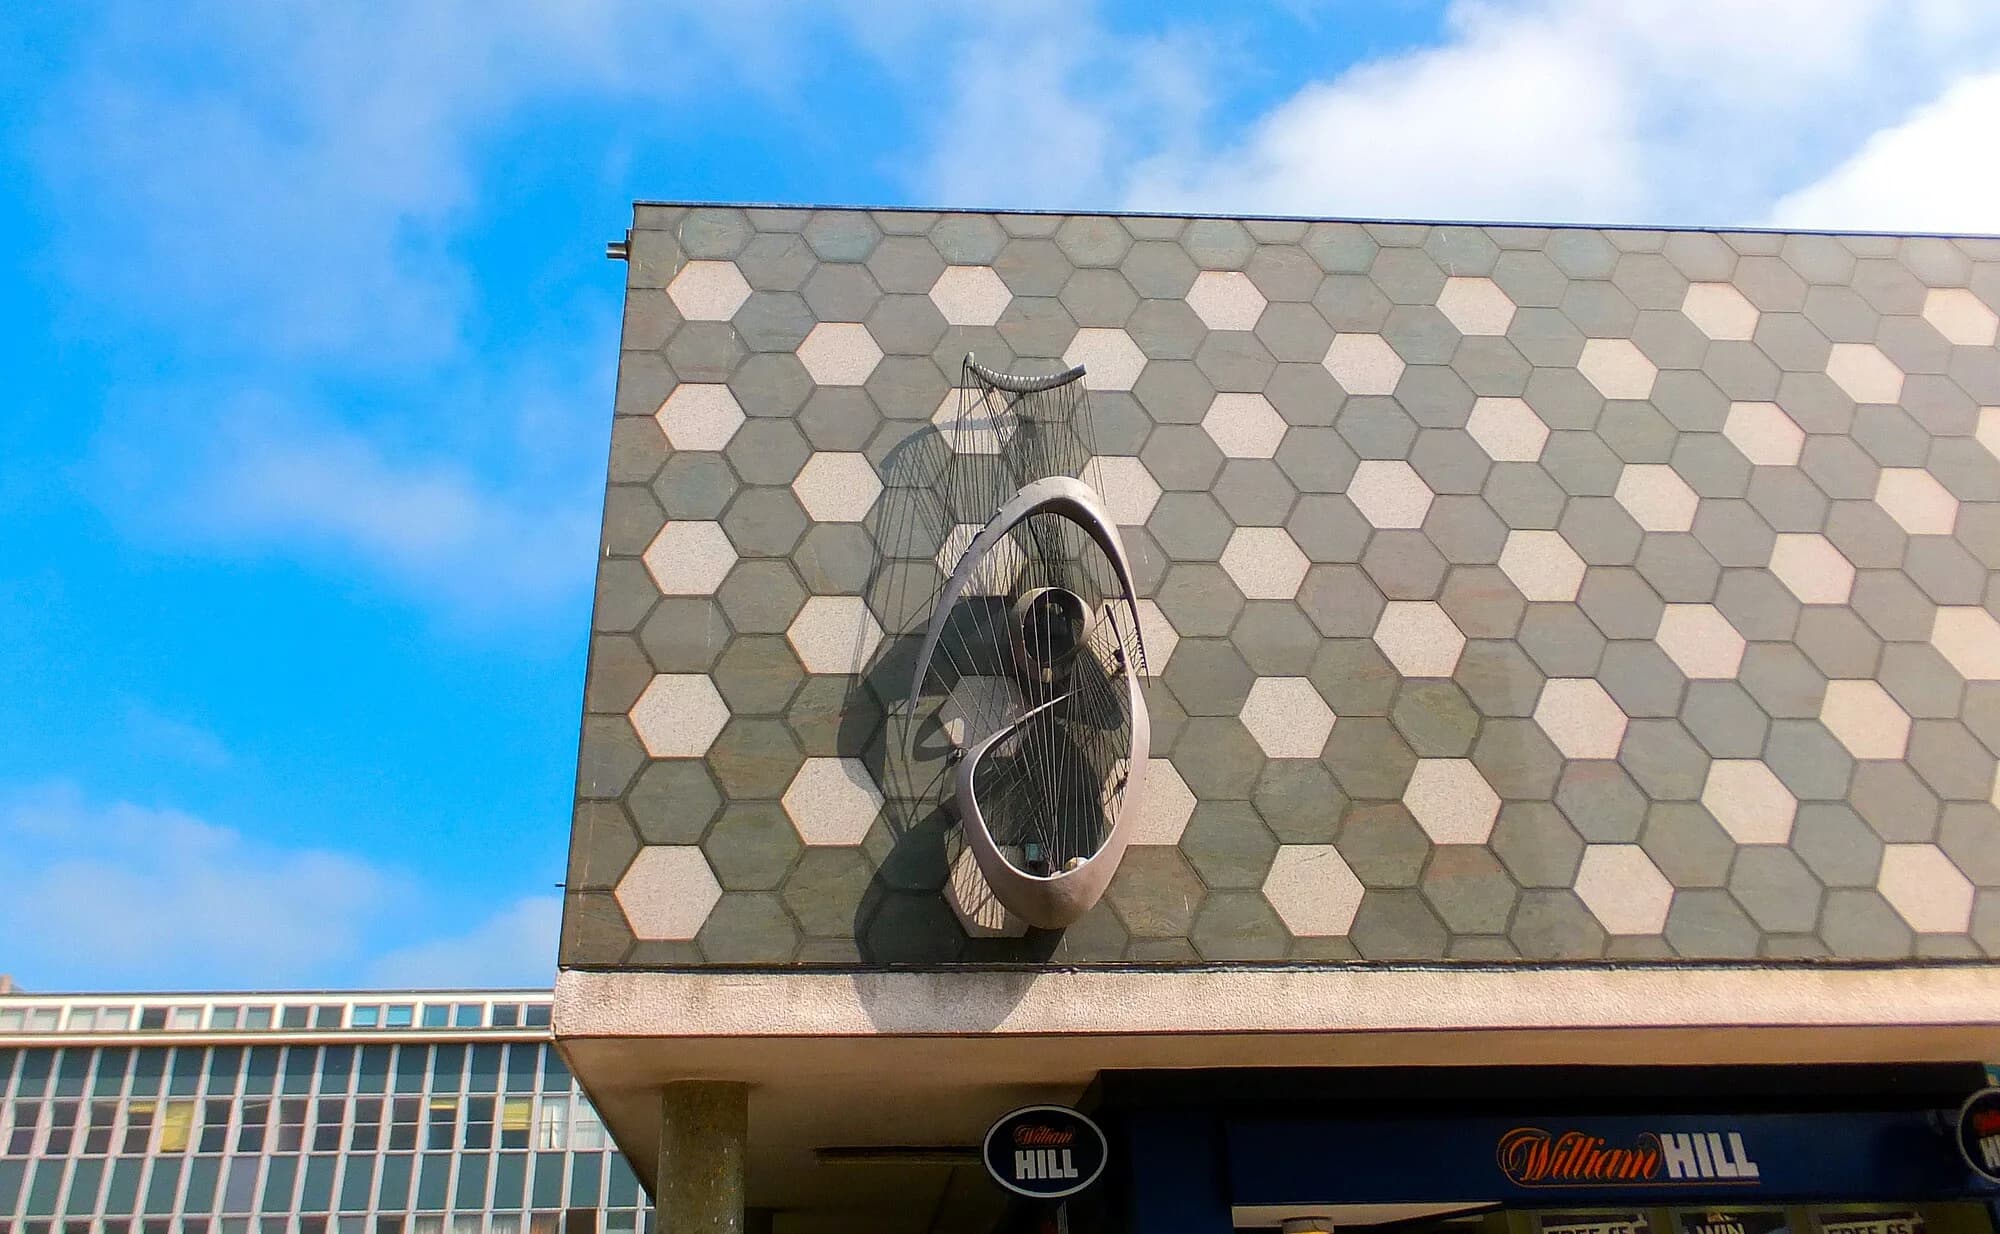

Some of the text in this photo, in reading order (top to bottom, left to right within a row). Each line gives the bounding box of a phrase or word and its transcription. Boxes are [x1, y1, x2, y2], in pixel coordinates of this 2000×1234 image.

[1013, 1124, 1075, 1146] William
[1014, 1148, 1079, 1179] HILL
[1496, 1127, 1760, 1182] William HILL
